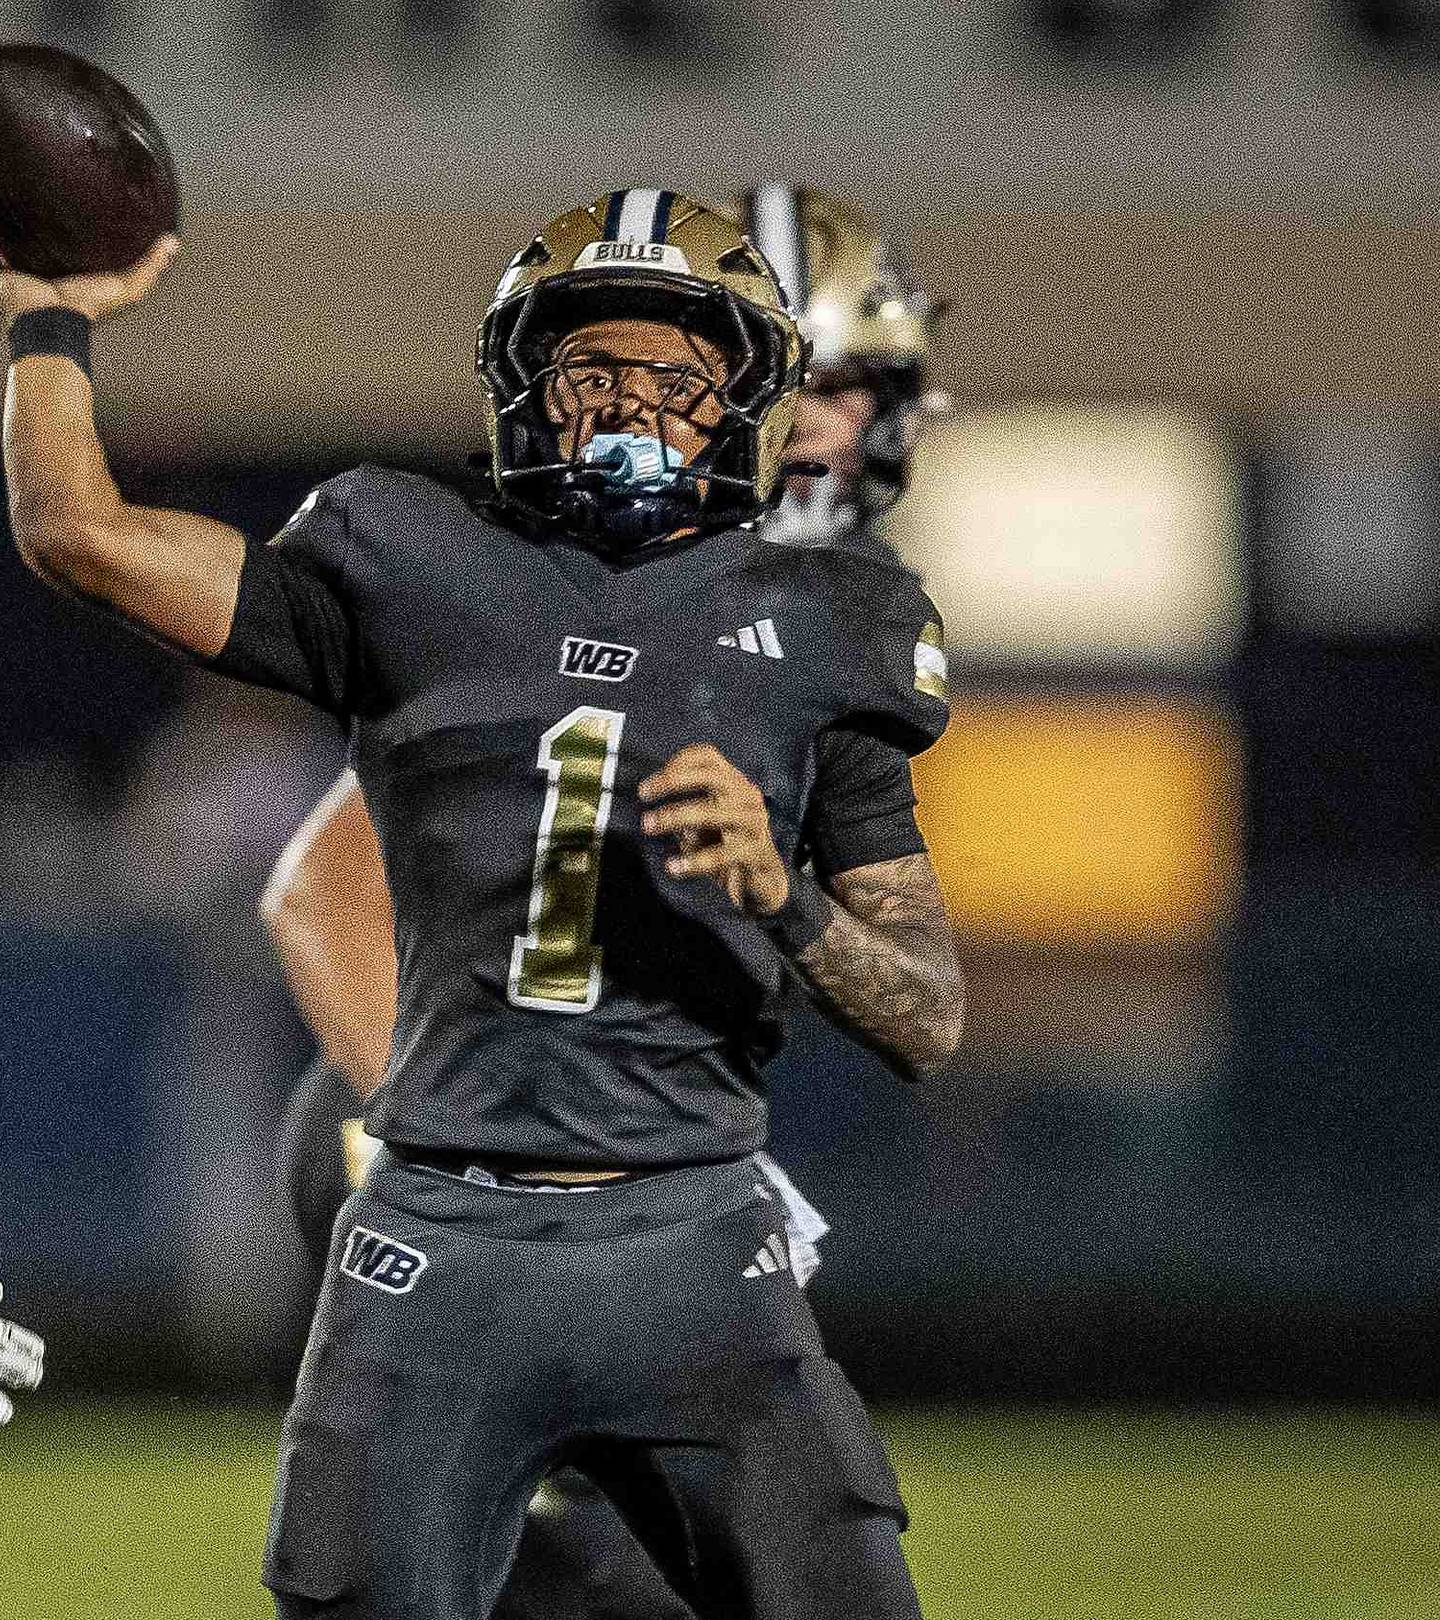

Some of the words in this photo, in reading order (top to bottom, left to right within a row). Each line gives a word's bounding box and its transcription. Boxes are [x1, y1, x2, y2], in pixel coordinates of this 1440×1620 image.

[594, 243, 665, 263] BULLS
[560, 636, 639, 682] WB
[509, 706, 626, 1014] 1
[341, 1226, 428, 1294] WB
